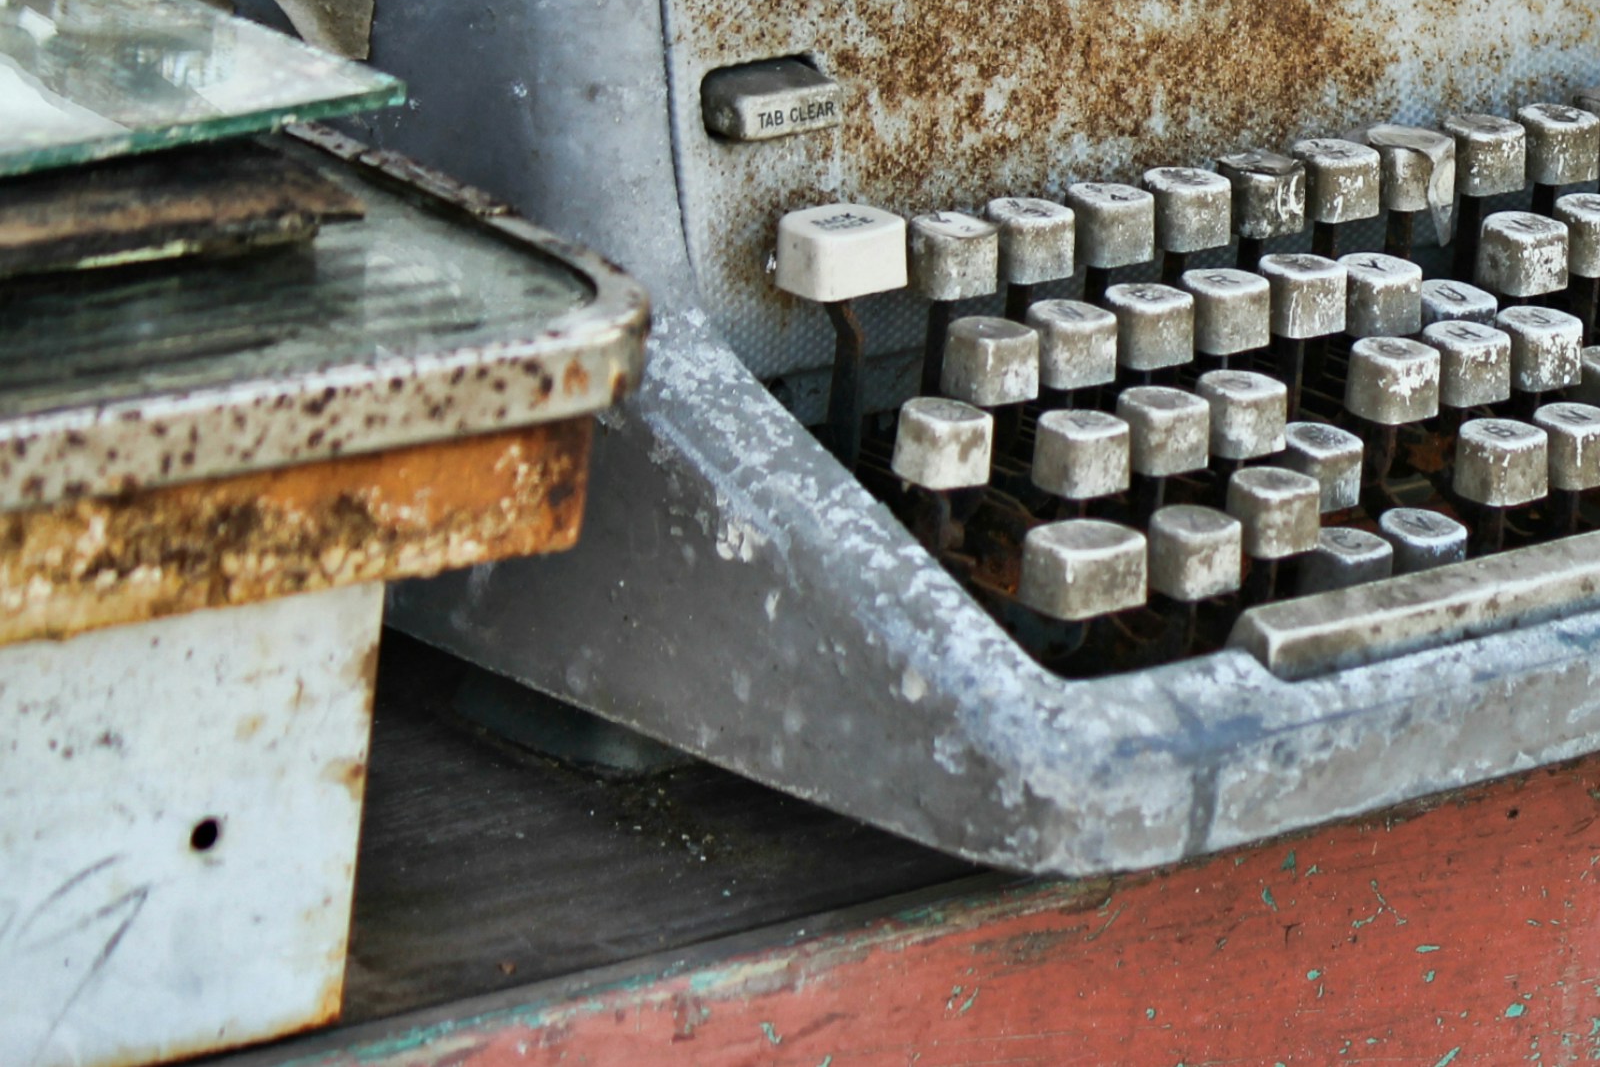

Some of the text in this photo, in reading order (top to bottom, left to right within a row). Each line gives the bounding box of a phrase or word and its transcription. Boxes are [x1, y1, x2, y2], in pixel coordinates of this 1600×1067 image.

[758, 100, 835, 129] TAB CLEAR
[1357, 259, 1387, 272] Y
[1205, 274, 1240, 285] R
[1435, 287, 1467, 302] U
[1447, 326, 1483, 340] H
[1555, 409, 1593, 424] N
[1482, 423, 1517, 438] B
[1331, 535, 1362, 550] C
